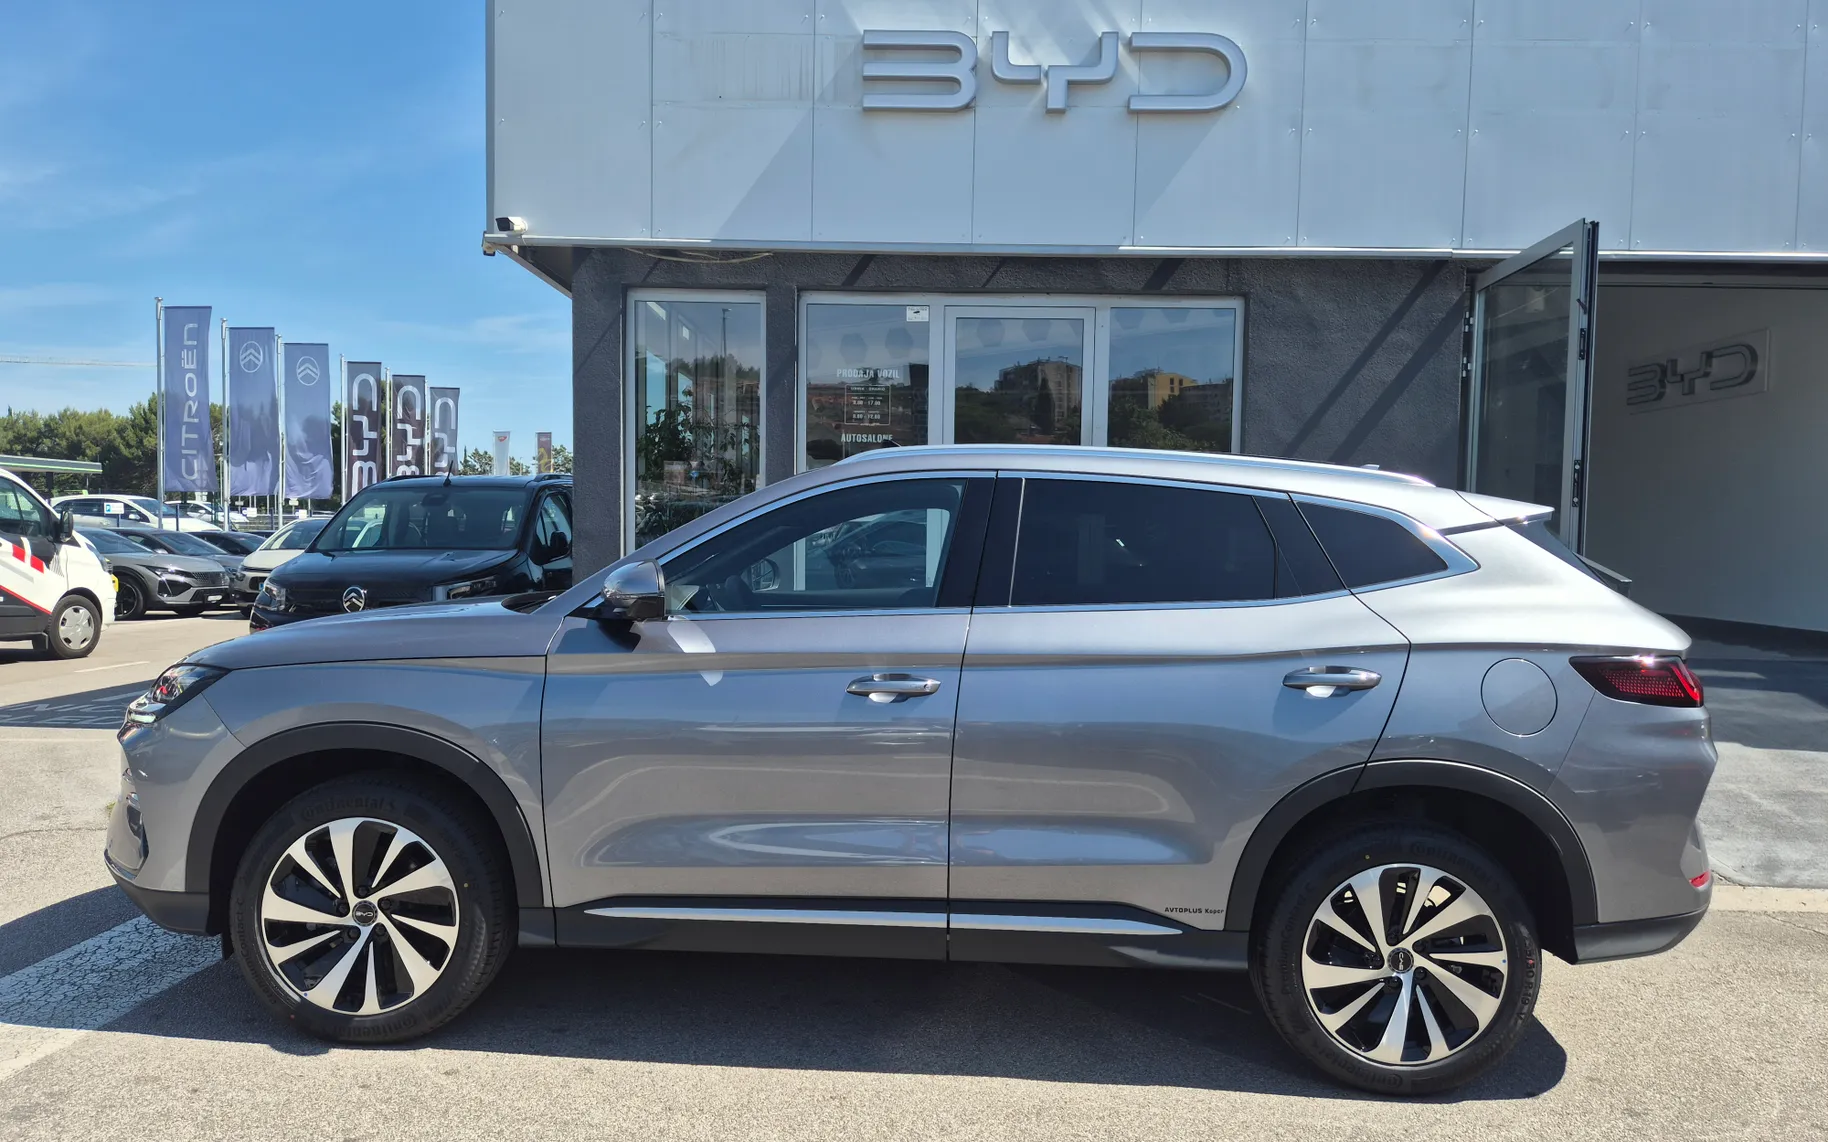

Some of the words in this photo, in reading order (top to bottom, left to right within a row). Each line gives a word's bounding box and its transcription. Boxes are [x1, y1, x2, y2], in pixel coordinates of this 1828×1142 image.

[862, 29, 1248, 113] BYD
[836, 368, 874, 379] PRODAJA
[877, 368, 900, 379] VOZIL
[1626, 343, 1758, 406] BYD
[352, 372, 378, 498] BYD
[433, 396, 456, 476] YD
[1164, 906, 1203, 914] AVTOPLUS
